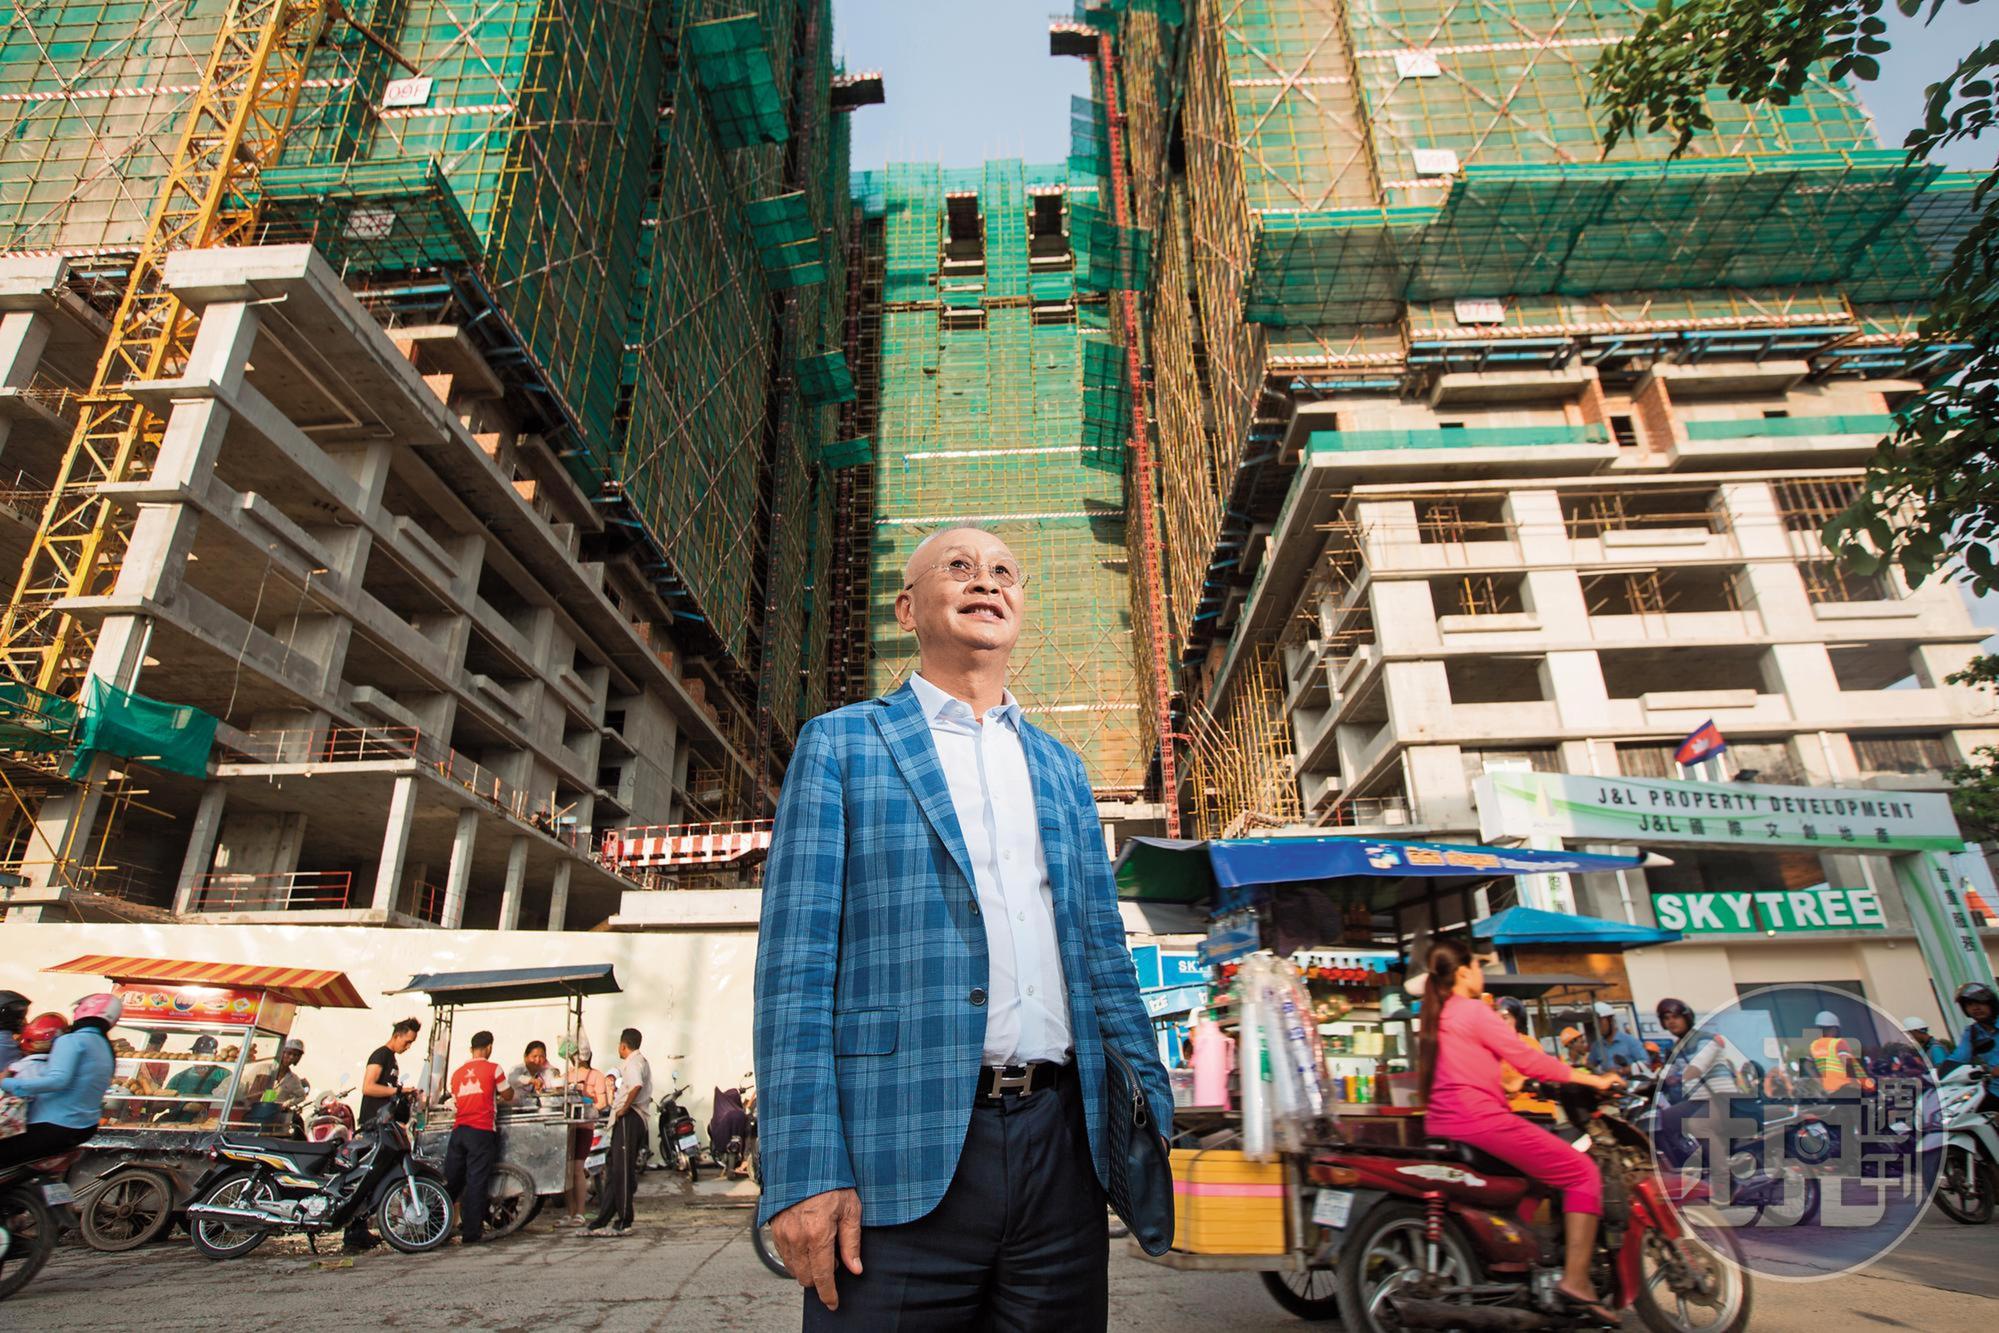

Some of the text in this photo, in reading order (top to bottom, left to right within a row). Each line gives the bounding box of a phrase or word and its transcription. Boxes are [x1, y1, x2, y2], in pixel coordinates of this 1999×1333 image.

[1598, 787, 1915, 819] J&L PROPERTY DEVELOPMENT
[1639, 814, 1680, 833] J&L
[1658, 890, 1881, 930] SKYTREE
